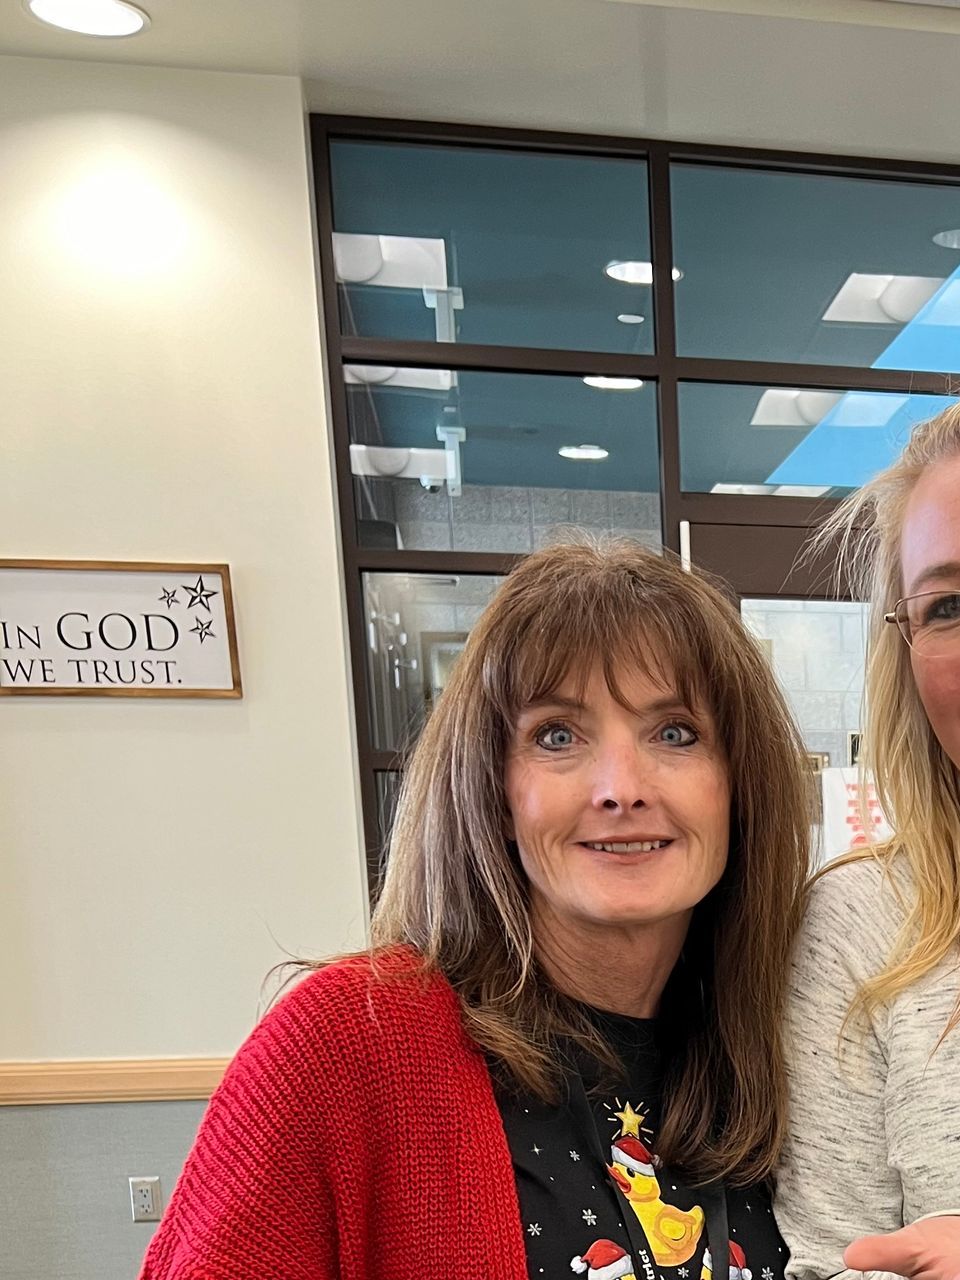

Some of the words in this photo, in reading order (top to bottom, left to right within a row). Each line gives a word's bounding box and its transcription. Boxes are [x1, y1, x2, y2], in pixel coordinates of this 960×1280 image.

[56, 612, 179, 651] GOD
[2, 658, 56, 684] WE
[67, 659, 182, 684] TRUST.
